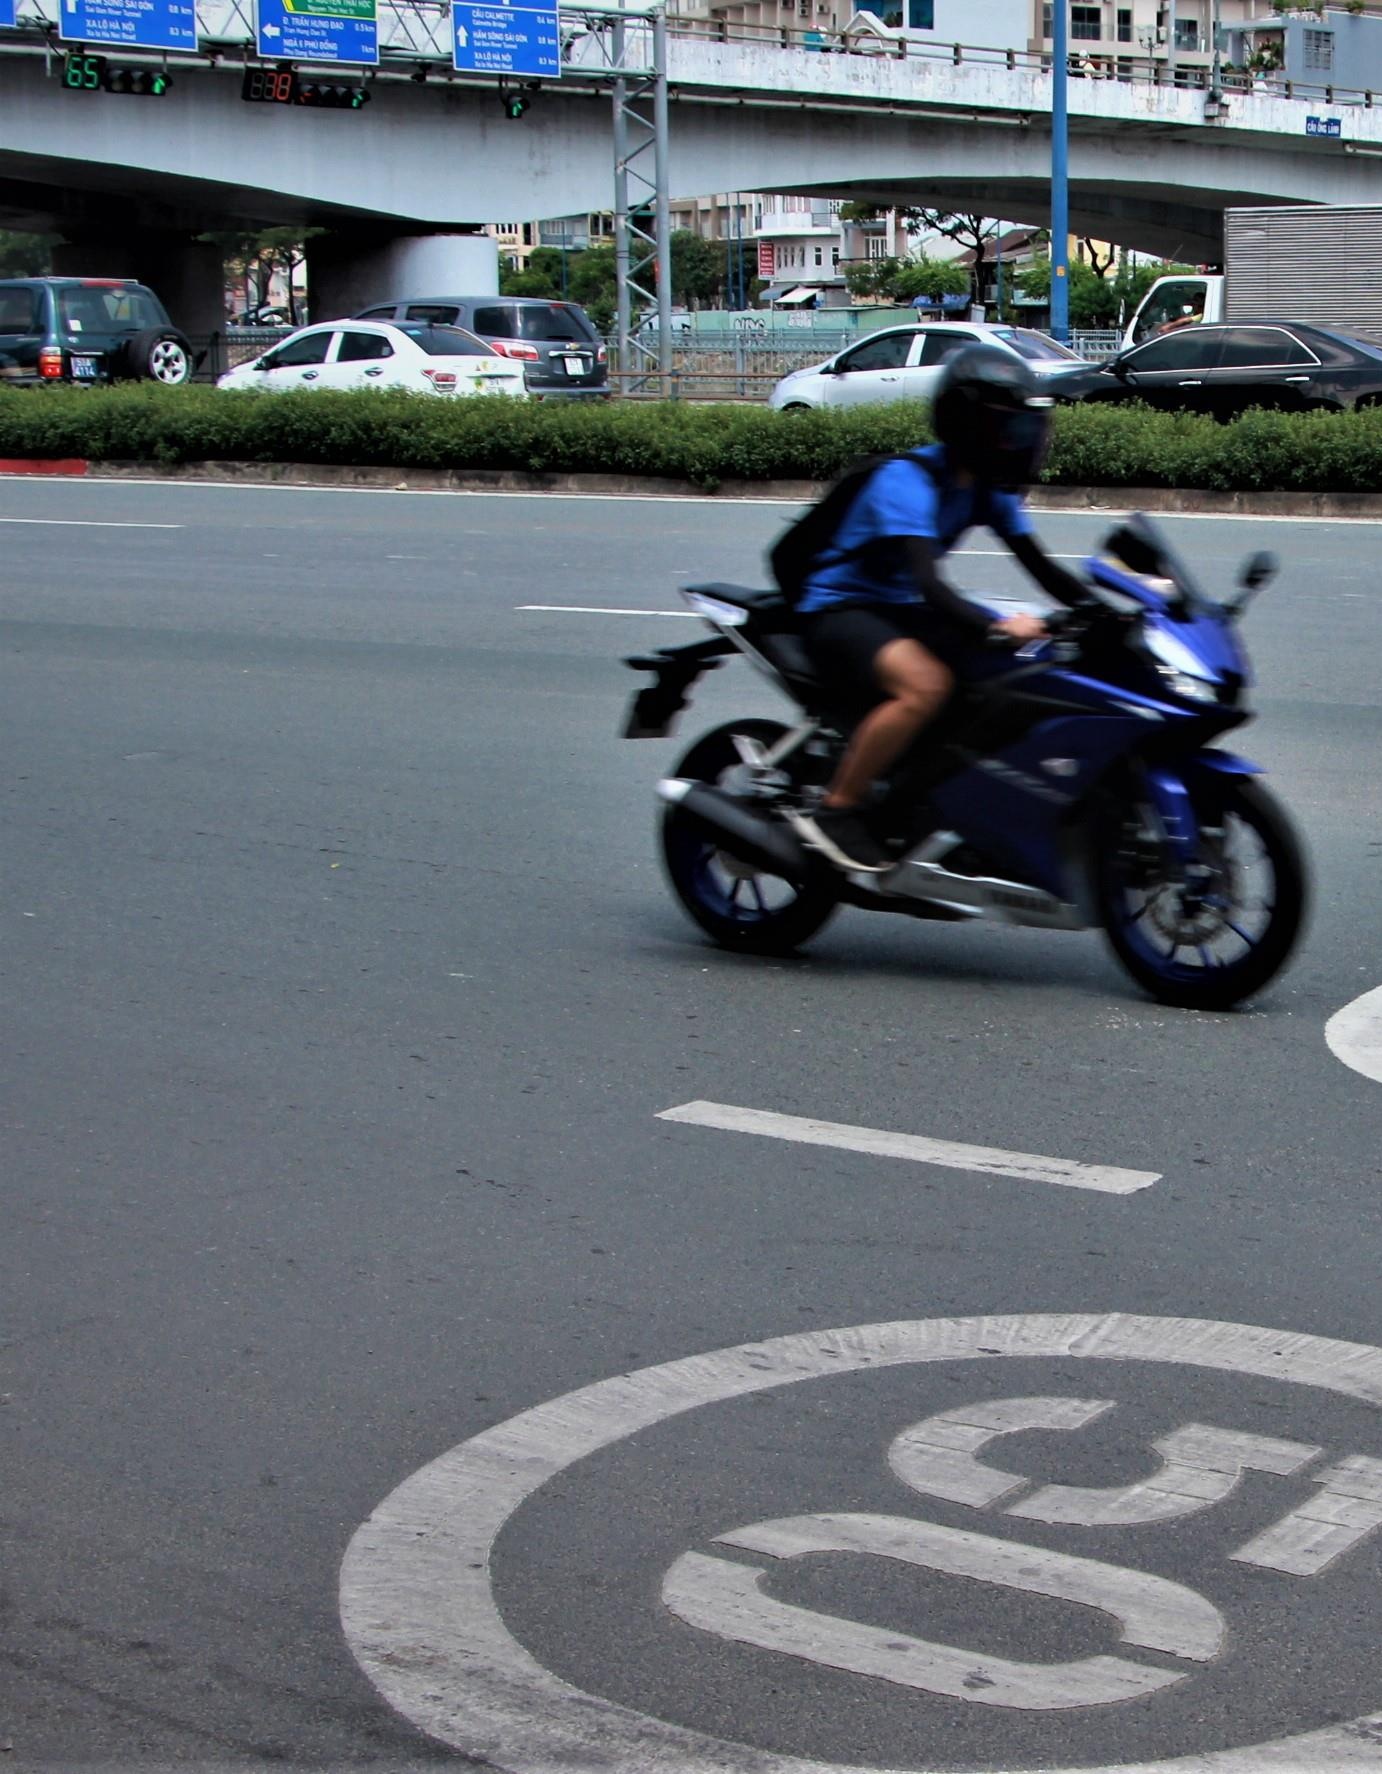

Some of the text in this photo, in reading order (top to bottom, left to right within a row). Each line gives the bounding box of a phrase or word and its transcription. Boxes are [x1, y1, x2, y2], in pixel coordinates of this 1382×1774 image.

[181, 6, 192, 14] km
[485, 11, 514, 22] CALMETTE
[365, 24, 375, 32] km
[182, 28, 193, 37] km
[548, 37, 557, 45] km
[365, 46, 375, 54] km
[548, 58, 558, 66] km
[67, 57, 98, 88] 65
